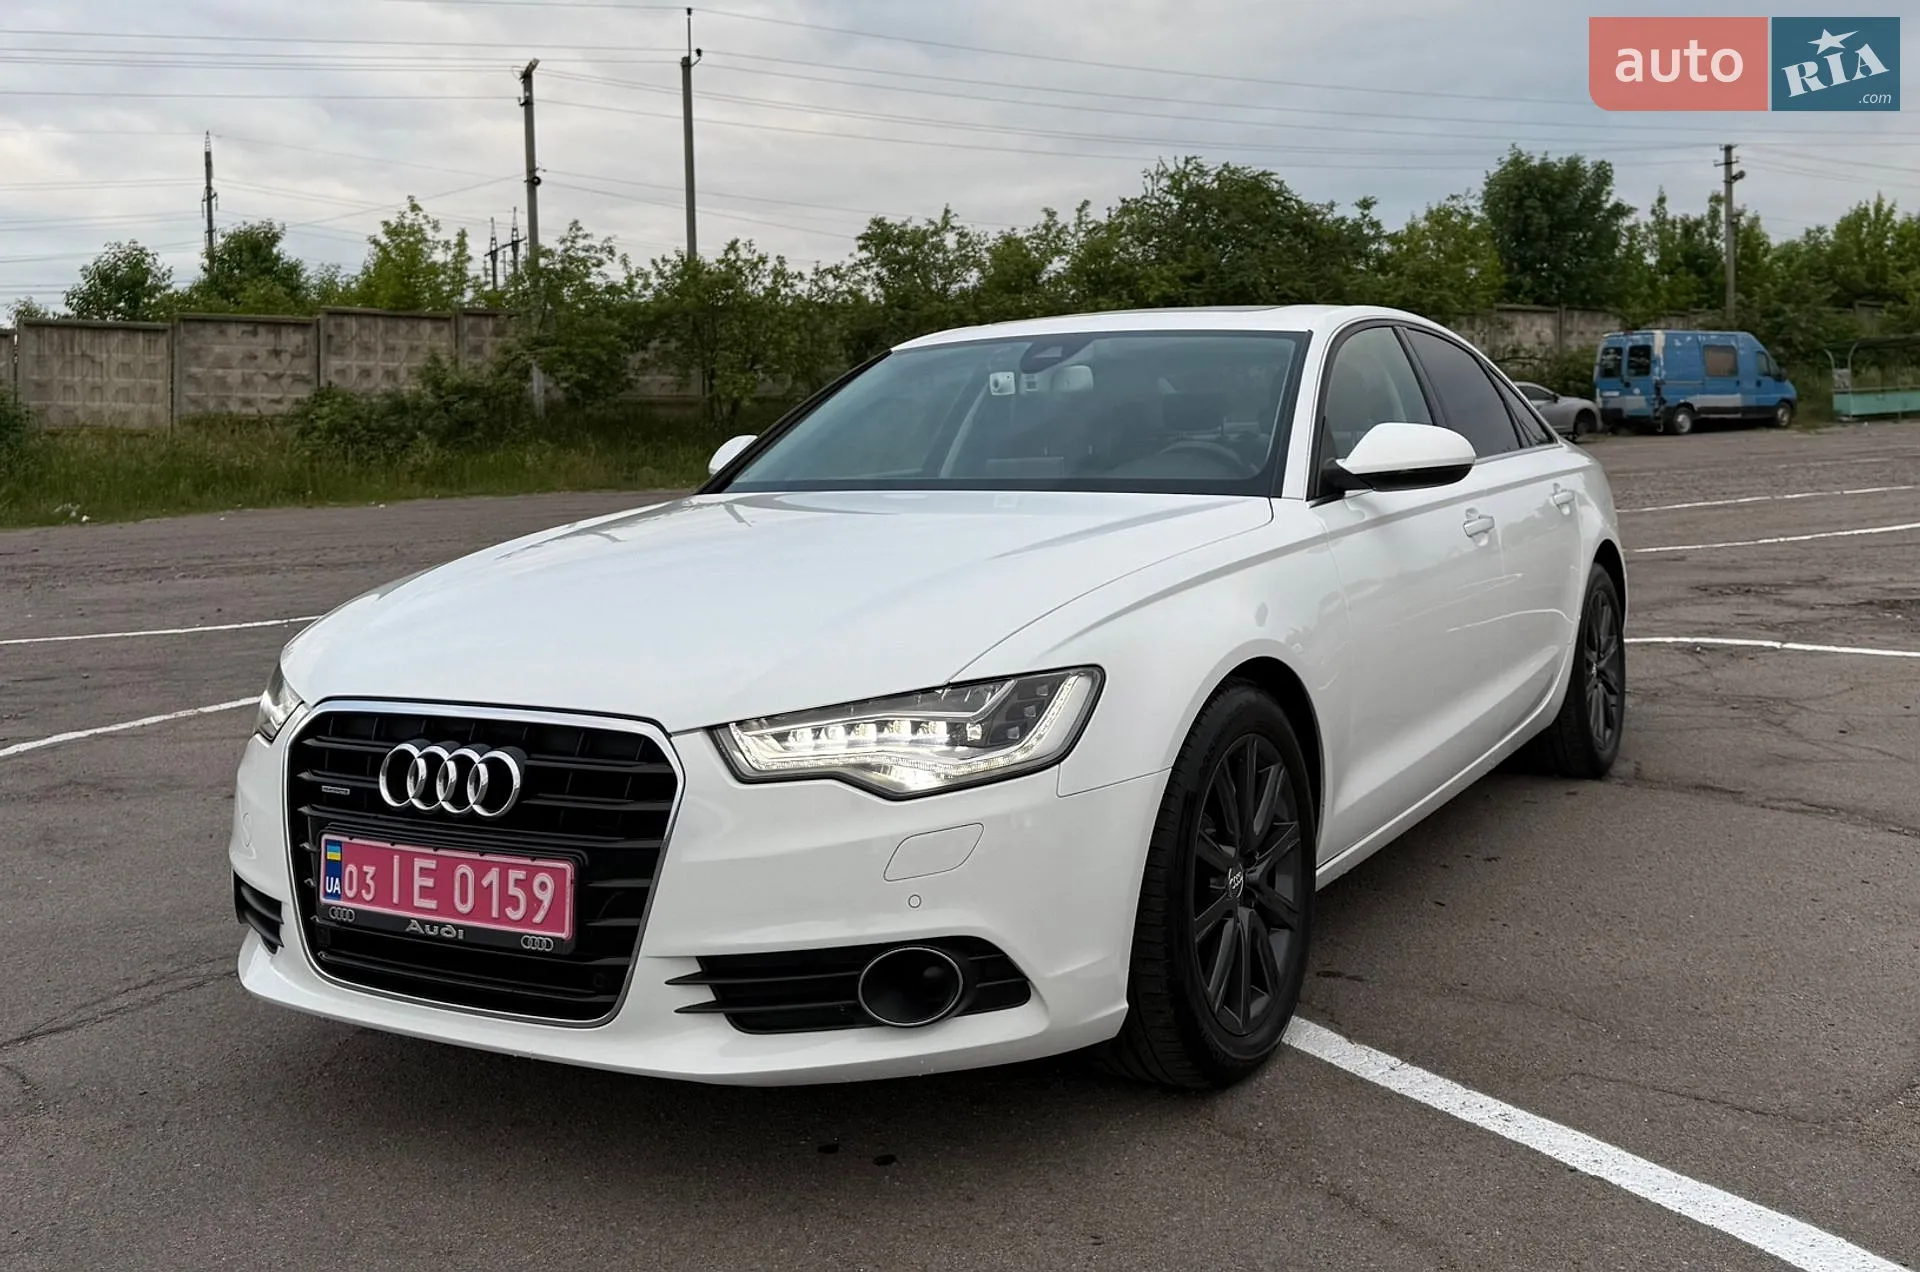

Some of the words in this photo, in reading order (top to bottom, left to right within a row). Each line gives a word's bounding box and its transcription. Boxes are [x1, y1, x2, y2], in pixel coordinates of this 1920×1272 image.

[325, 876, 341, 894] UA
[344, 864, 376, 901] 03
[453, 864, 555, 924] 0159
